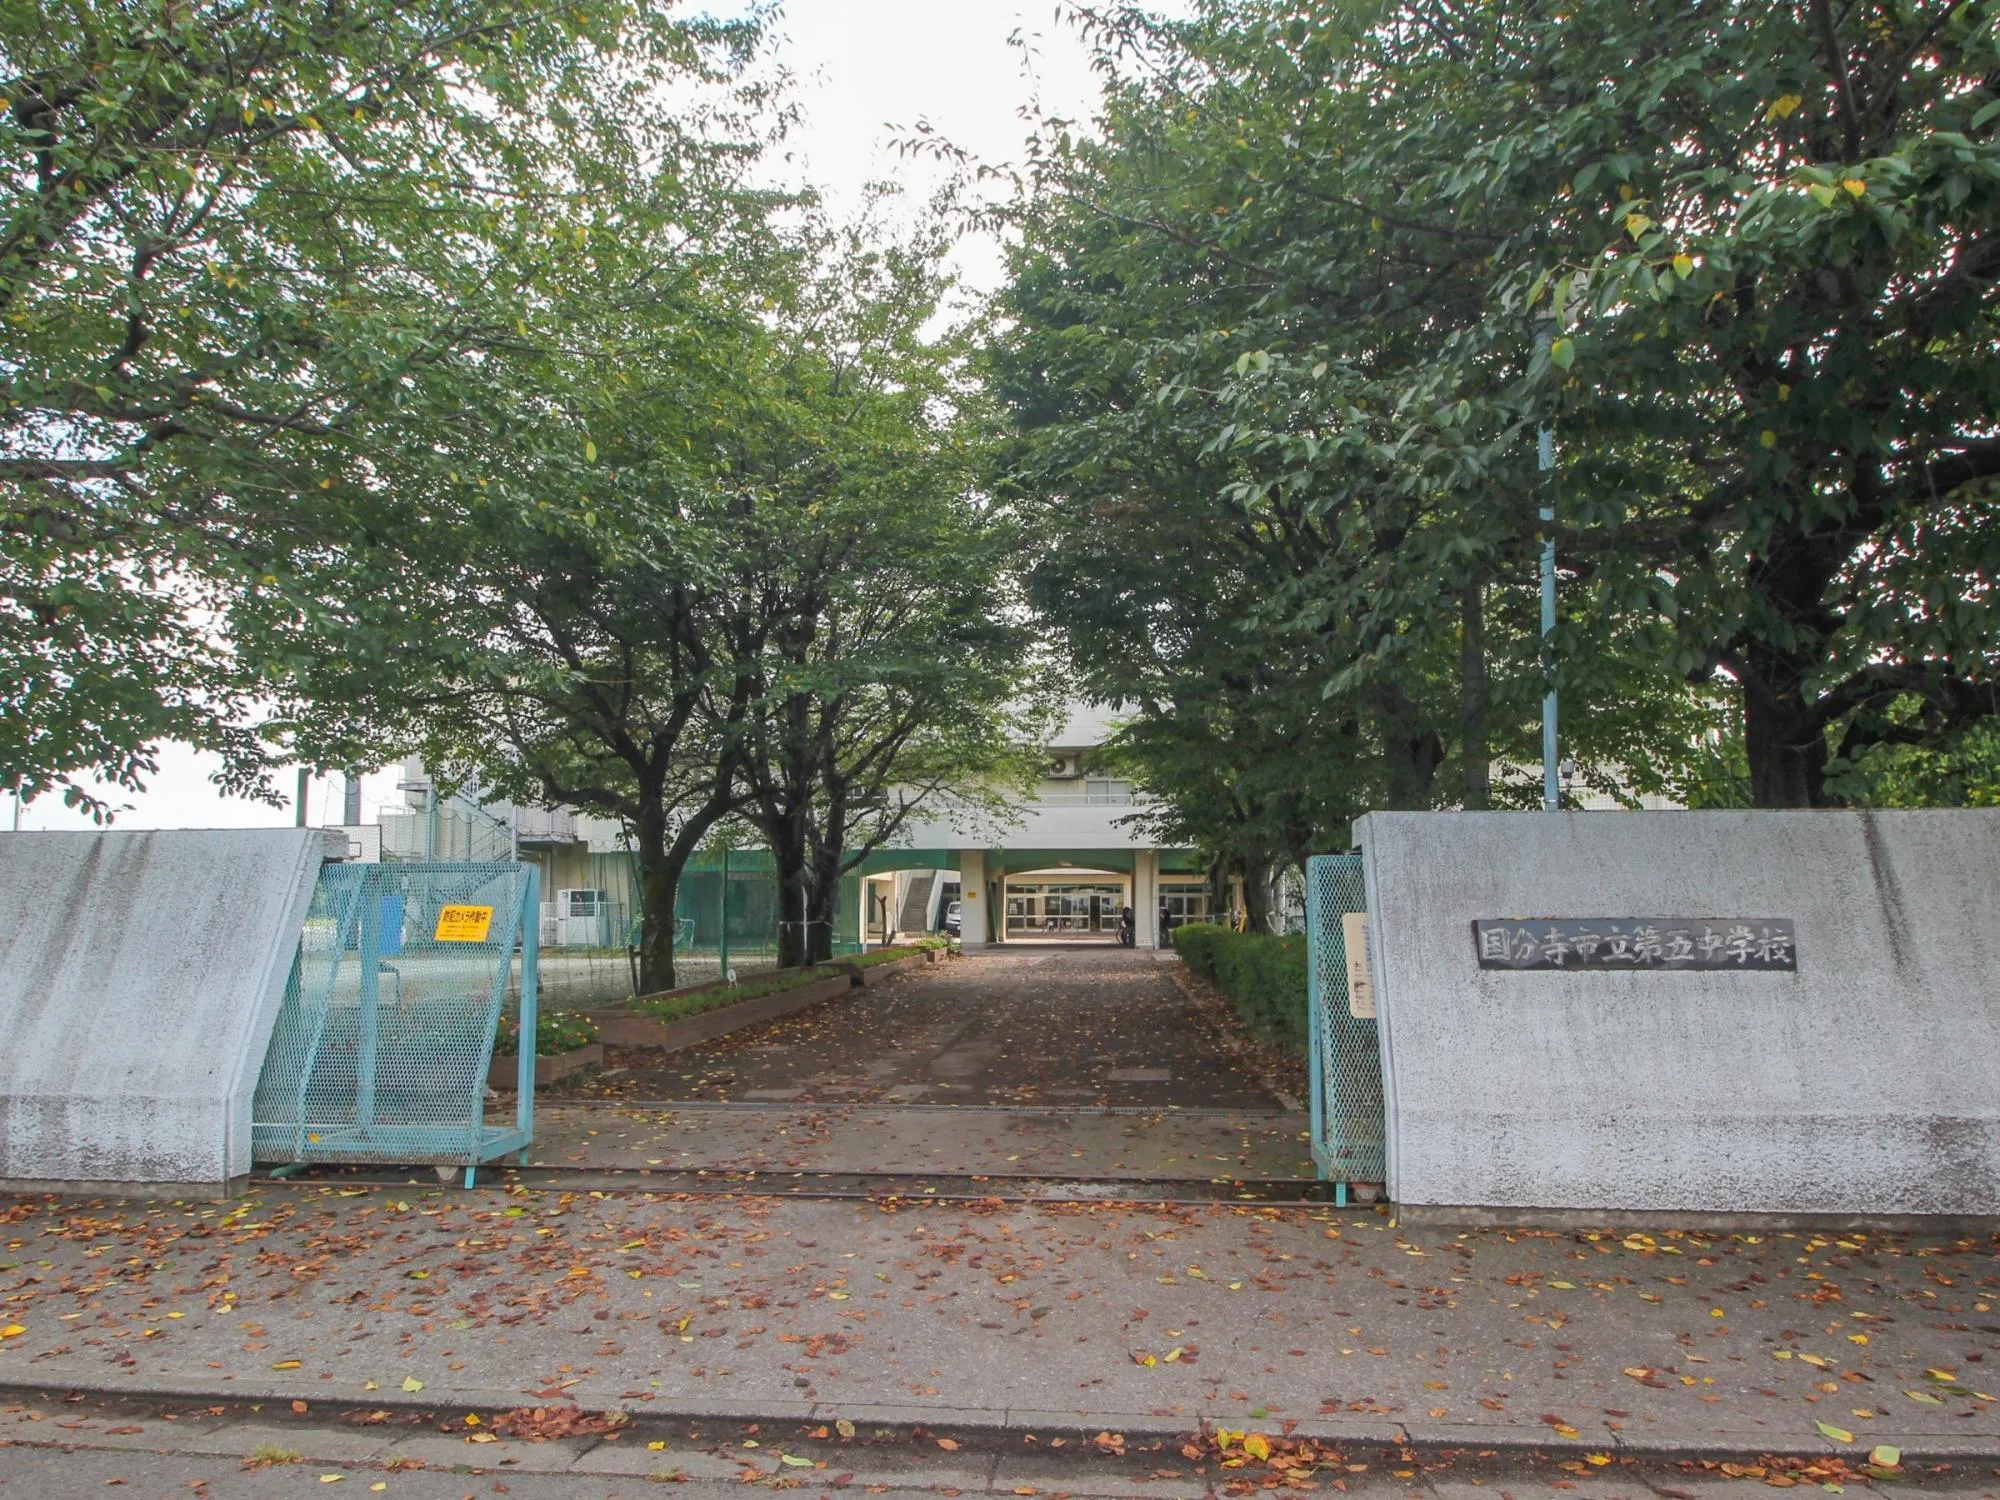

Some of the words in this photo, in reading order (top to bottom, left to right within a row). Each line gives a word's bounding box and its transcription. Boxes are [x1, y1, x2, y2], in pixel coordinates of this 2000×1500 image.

[1481, 925, 1791, 964] 国分寺市立第五中学校
